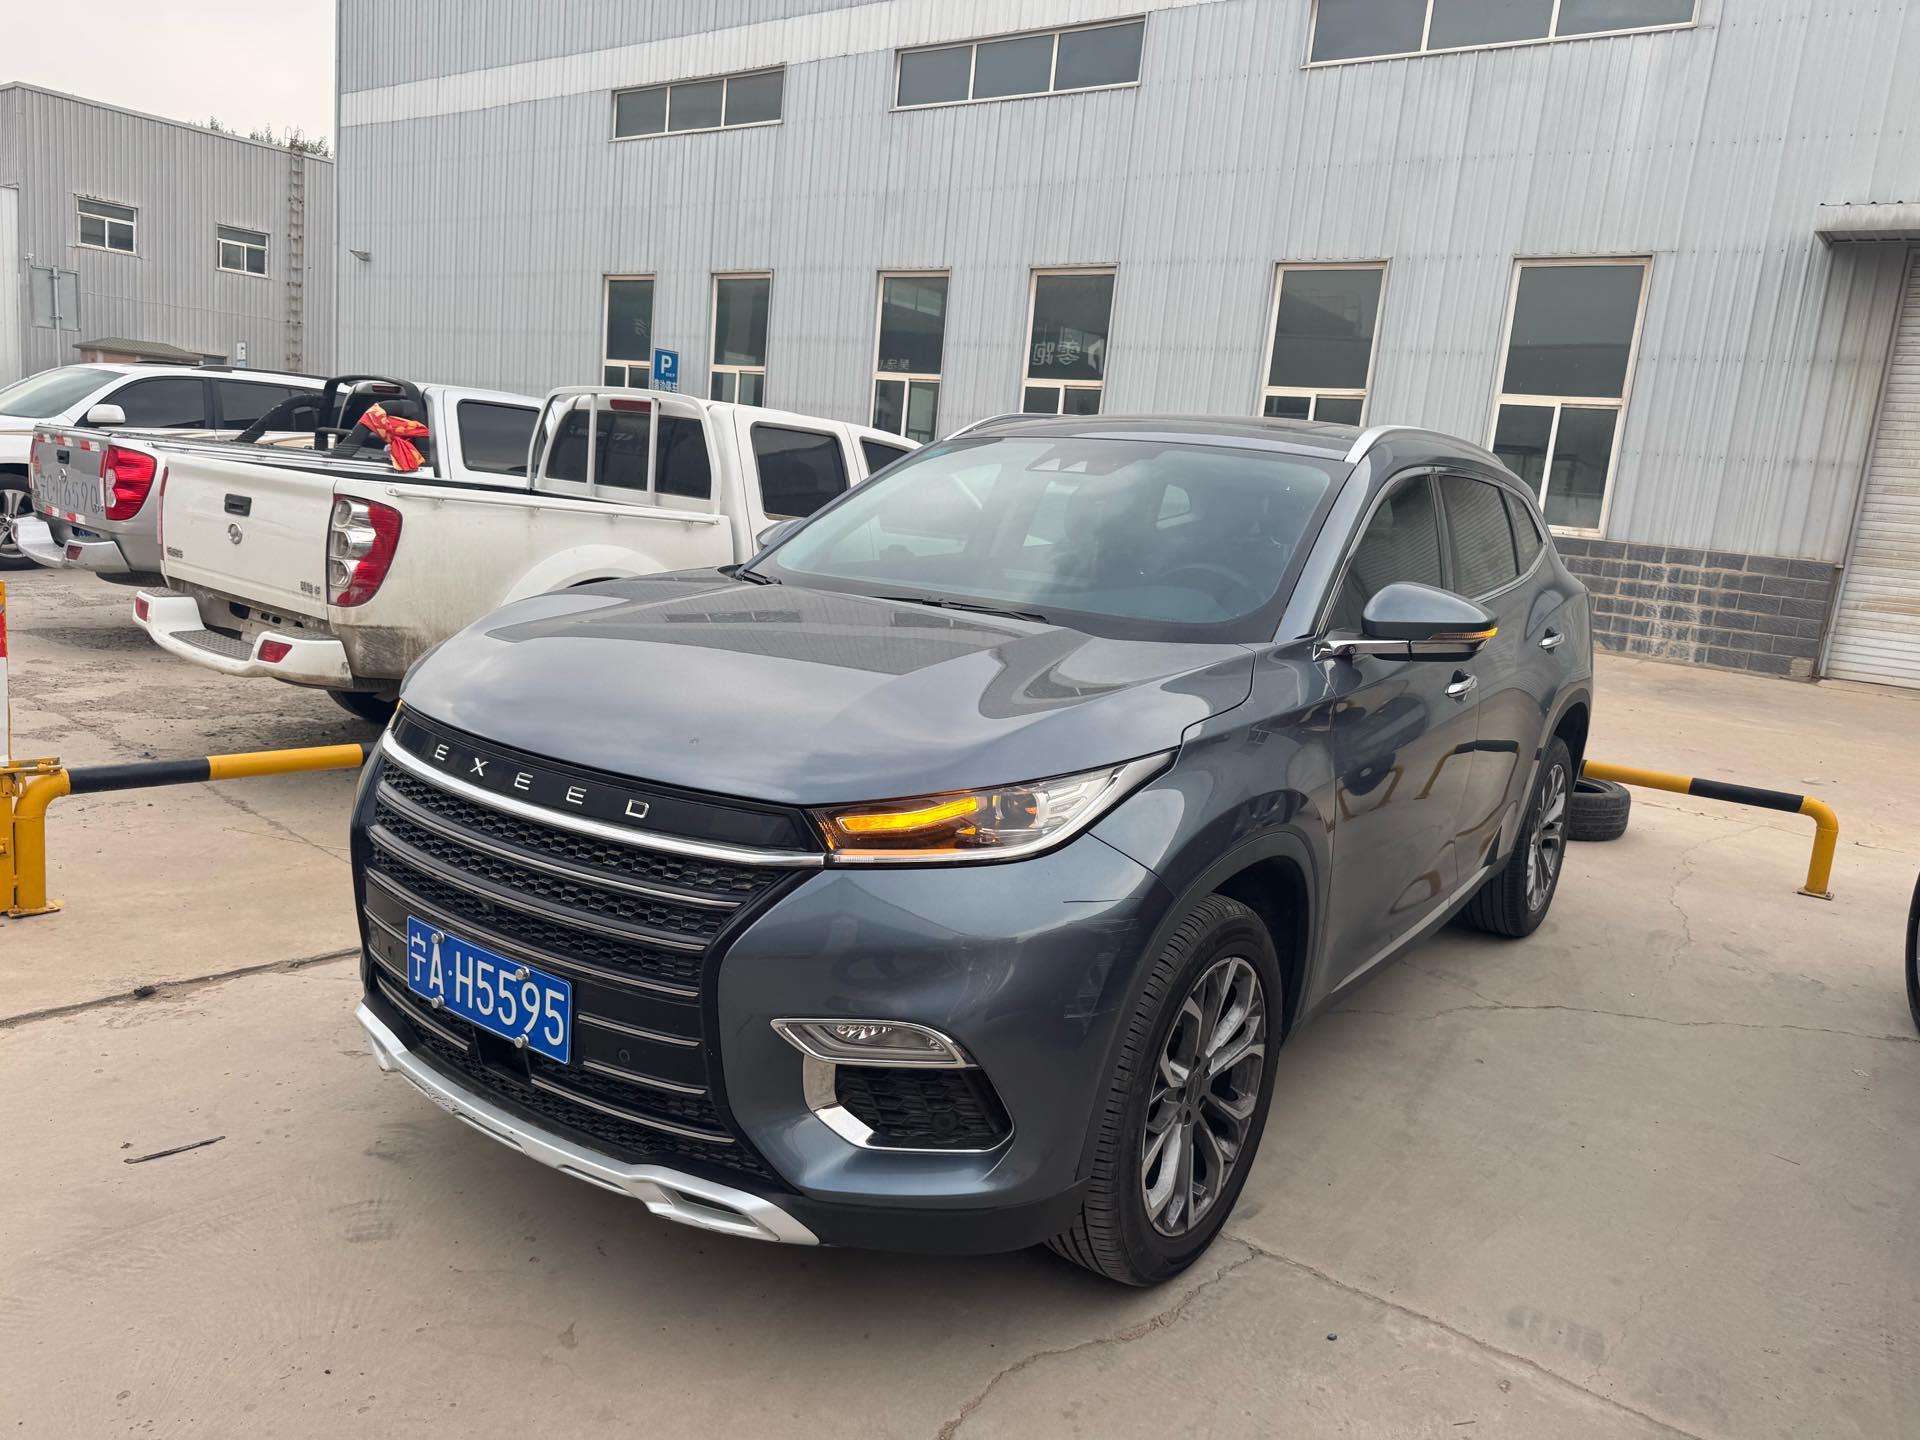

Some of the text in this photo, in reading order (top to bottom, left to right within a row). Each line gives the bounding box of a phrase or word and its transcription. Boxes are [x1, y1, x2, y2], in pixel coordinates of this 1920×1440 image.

[660, 355, 672, 374] P
[434, 743, 650, 819] EXEED
[410, 932, 565, 1046] 宁A·H5595
